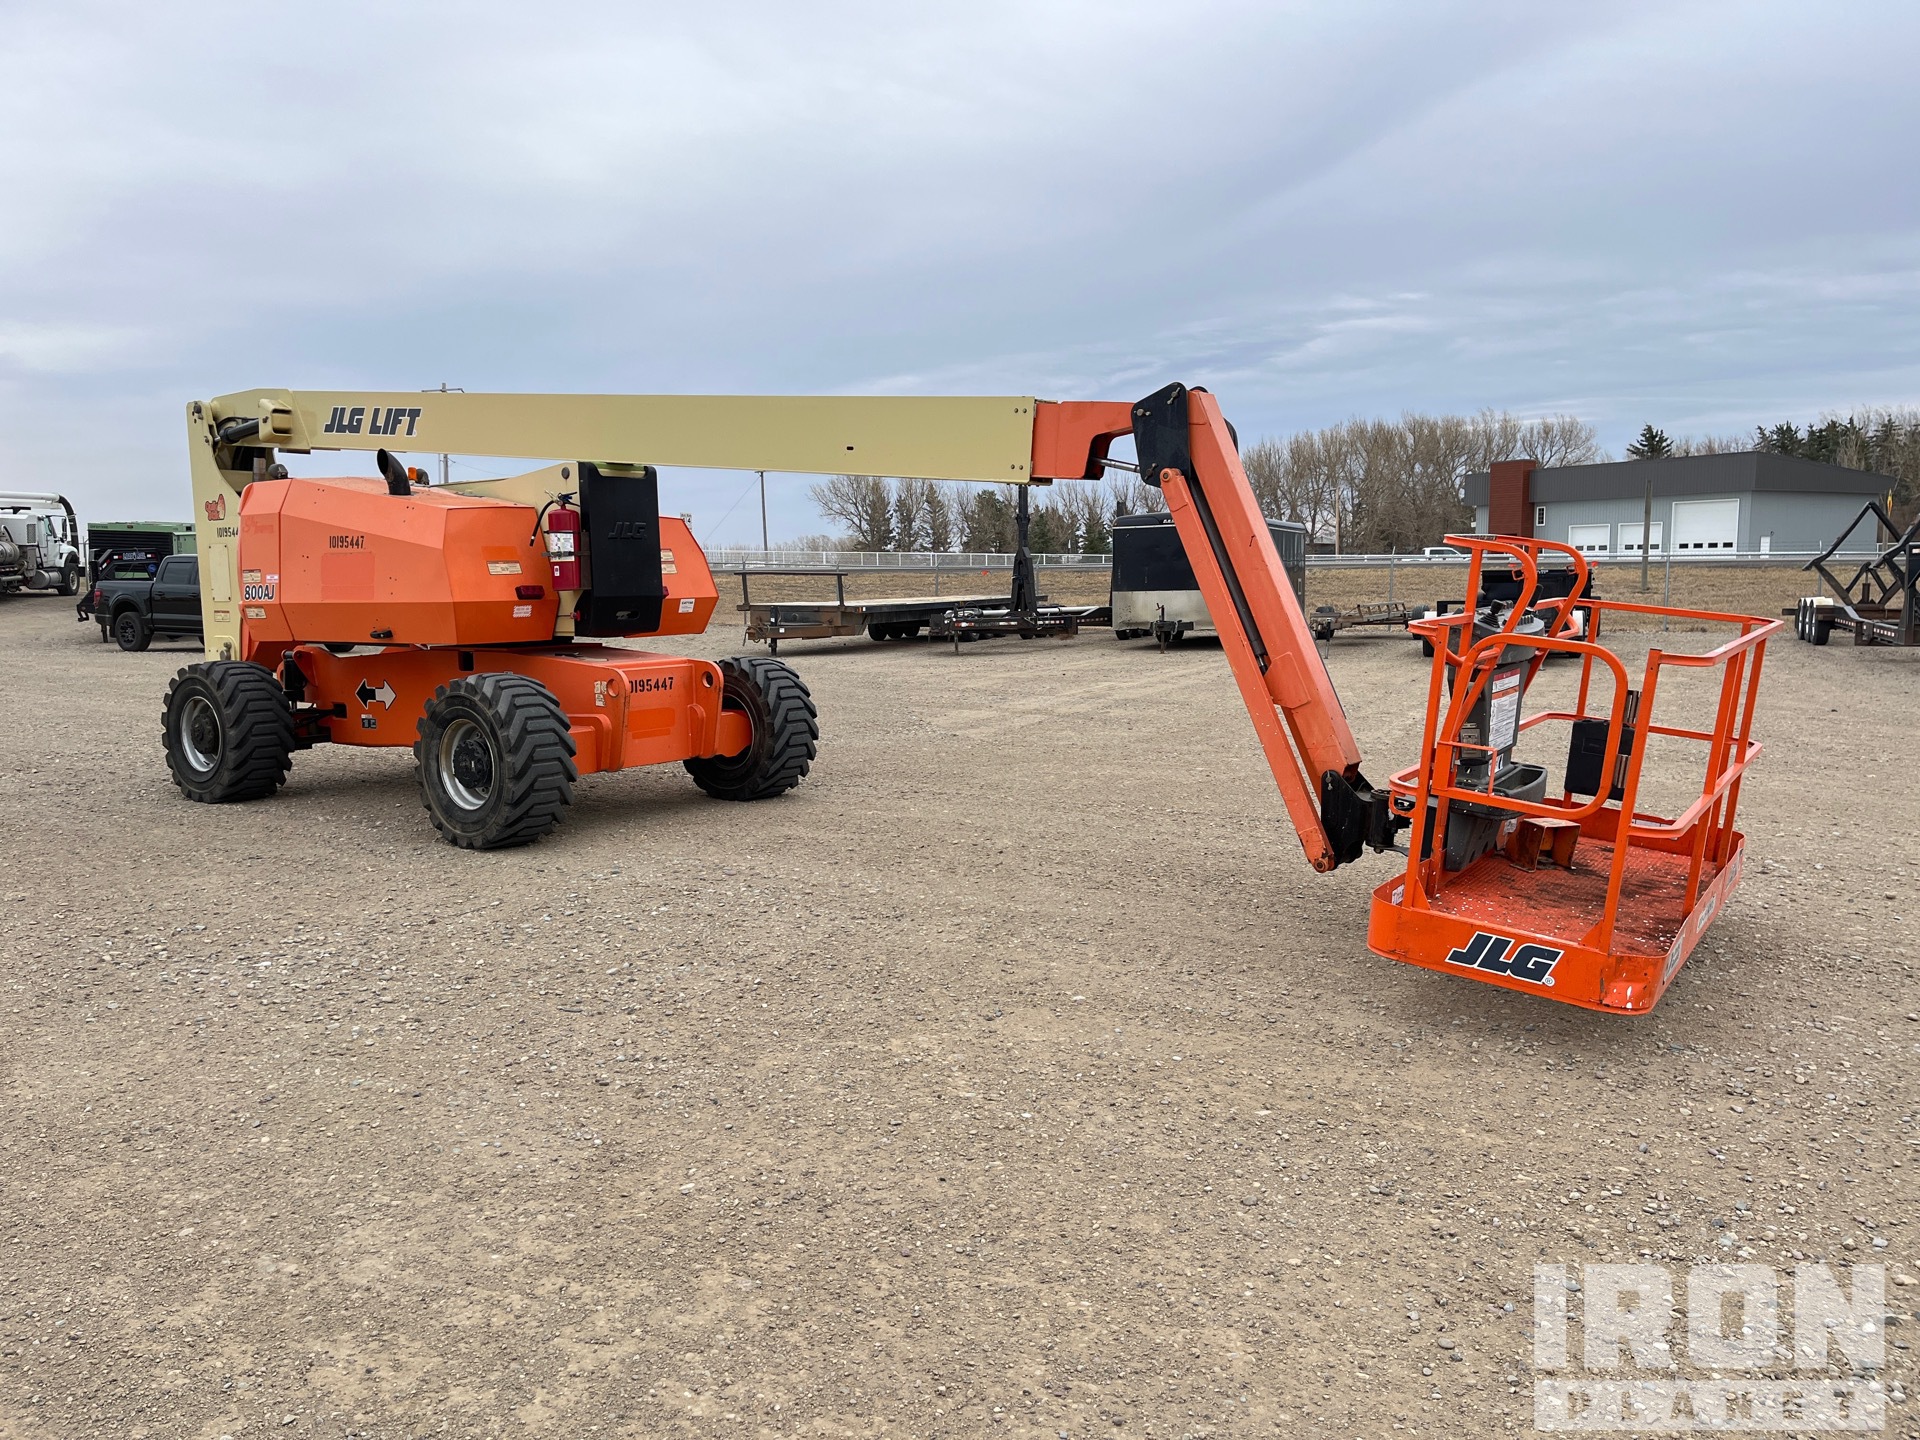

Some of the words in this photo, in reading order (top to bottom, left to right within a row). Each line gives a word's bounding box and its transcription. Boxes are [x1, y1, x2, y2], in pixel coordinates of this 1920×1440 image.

[323, 406, 366, 434] JLG
[368, 406, 422, 436] LIFT
[607, 521, 647, 540] JLG
[329, 535, 365, 549] 10195447
[244, 584, 276, 601] 800AJ
[1445, 931, 1565, 985] JLG
